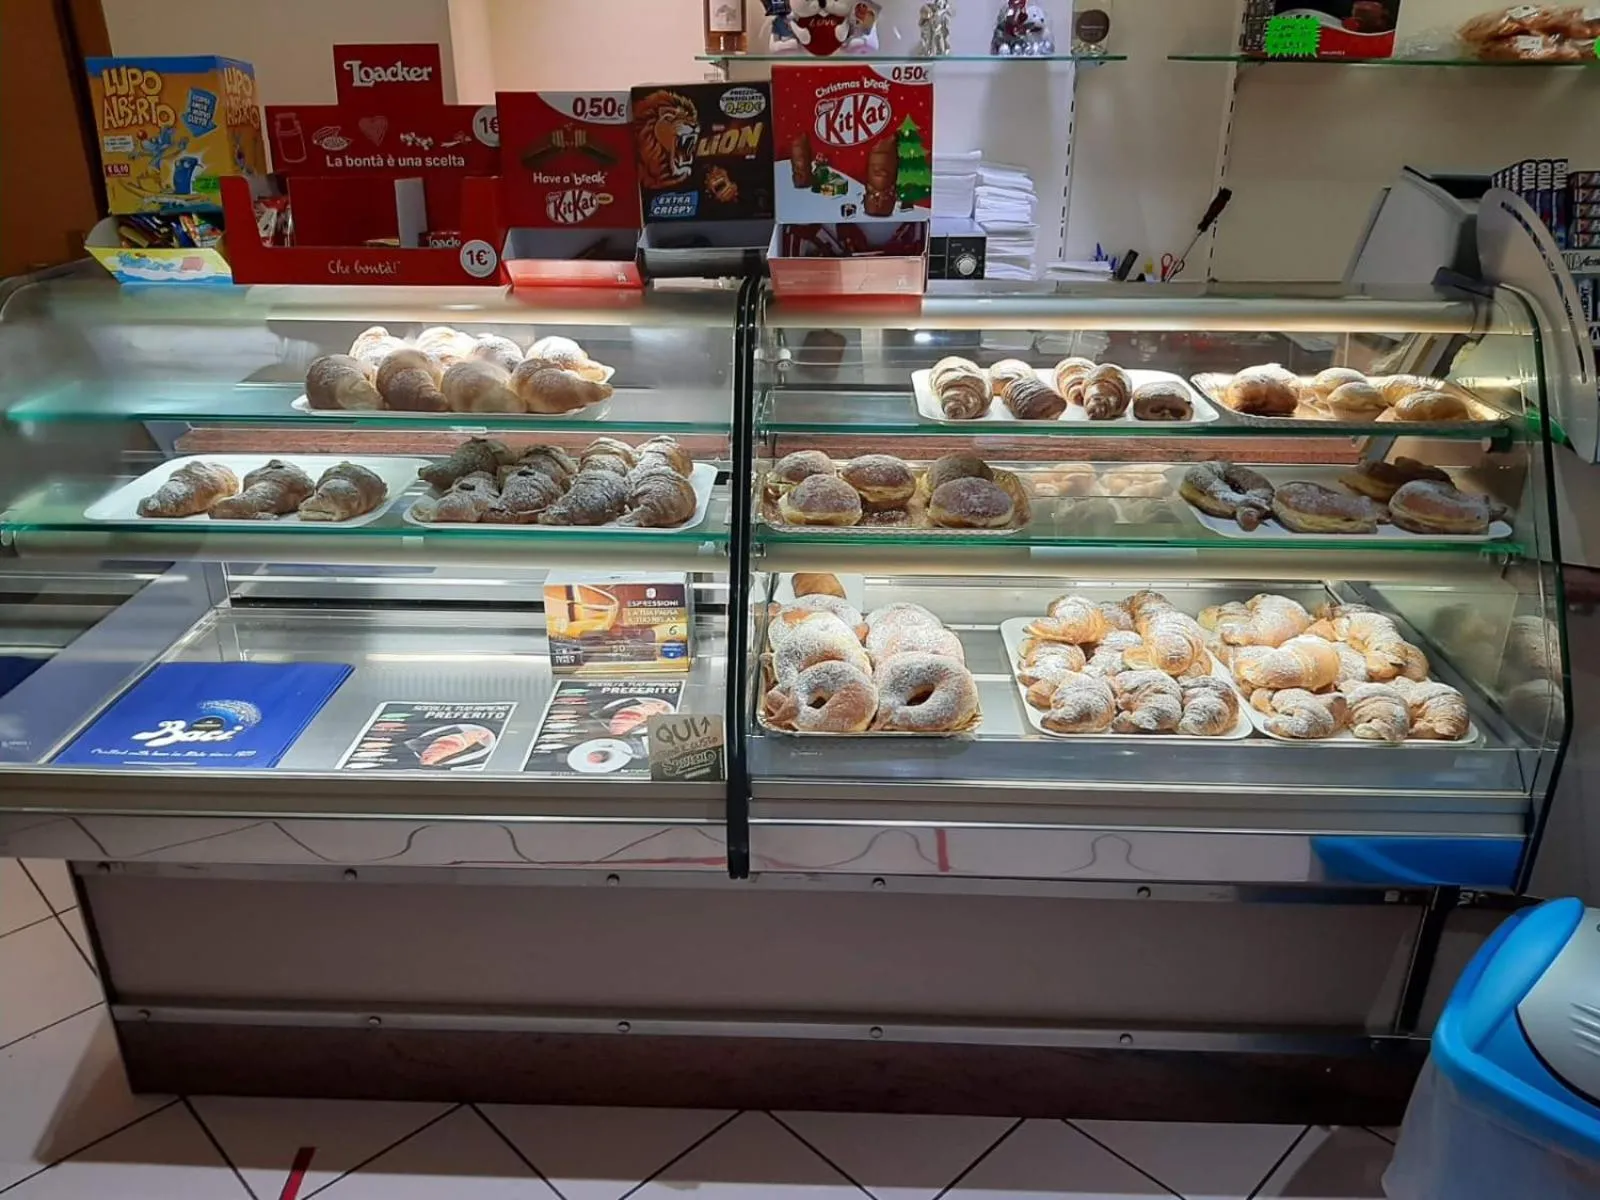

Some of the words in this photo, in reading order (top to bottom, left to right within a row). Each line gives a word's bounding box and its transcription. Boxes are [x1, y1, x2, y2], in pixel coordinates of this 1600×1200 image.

[102, 65, 162, 97] LUPO
[343, 60, 433, 87] Loacker
[815, 80, 860, 98] Christmas
[104, 95, 176, 129] ALBERTO
[572, 97, 625, 118] 0,50€
[825, 94, 887, 145] KitKat
[326, 155, 343, 167] La
[345, 154, 384, 167] bontà
[387, 154, 395, 167] è
[398, 158, 422, 167] una
[425, 155, 465, 167] scelta
[533, 172, 561, 184] Have
[553, 189, 595, 223] KitKat
[653, 206, 692, 215] CRISPY
[658, 196, 690, 204] EXTRA
[328, 259, 350, 274] Che
[424, 711, 505, 719] PREFERITO
[131, 720, 244, 747] Baci
[655, 717, 701, 746] QUI
